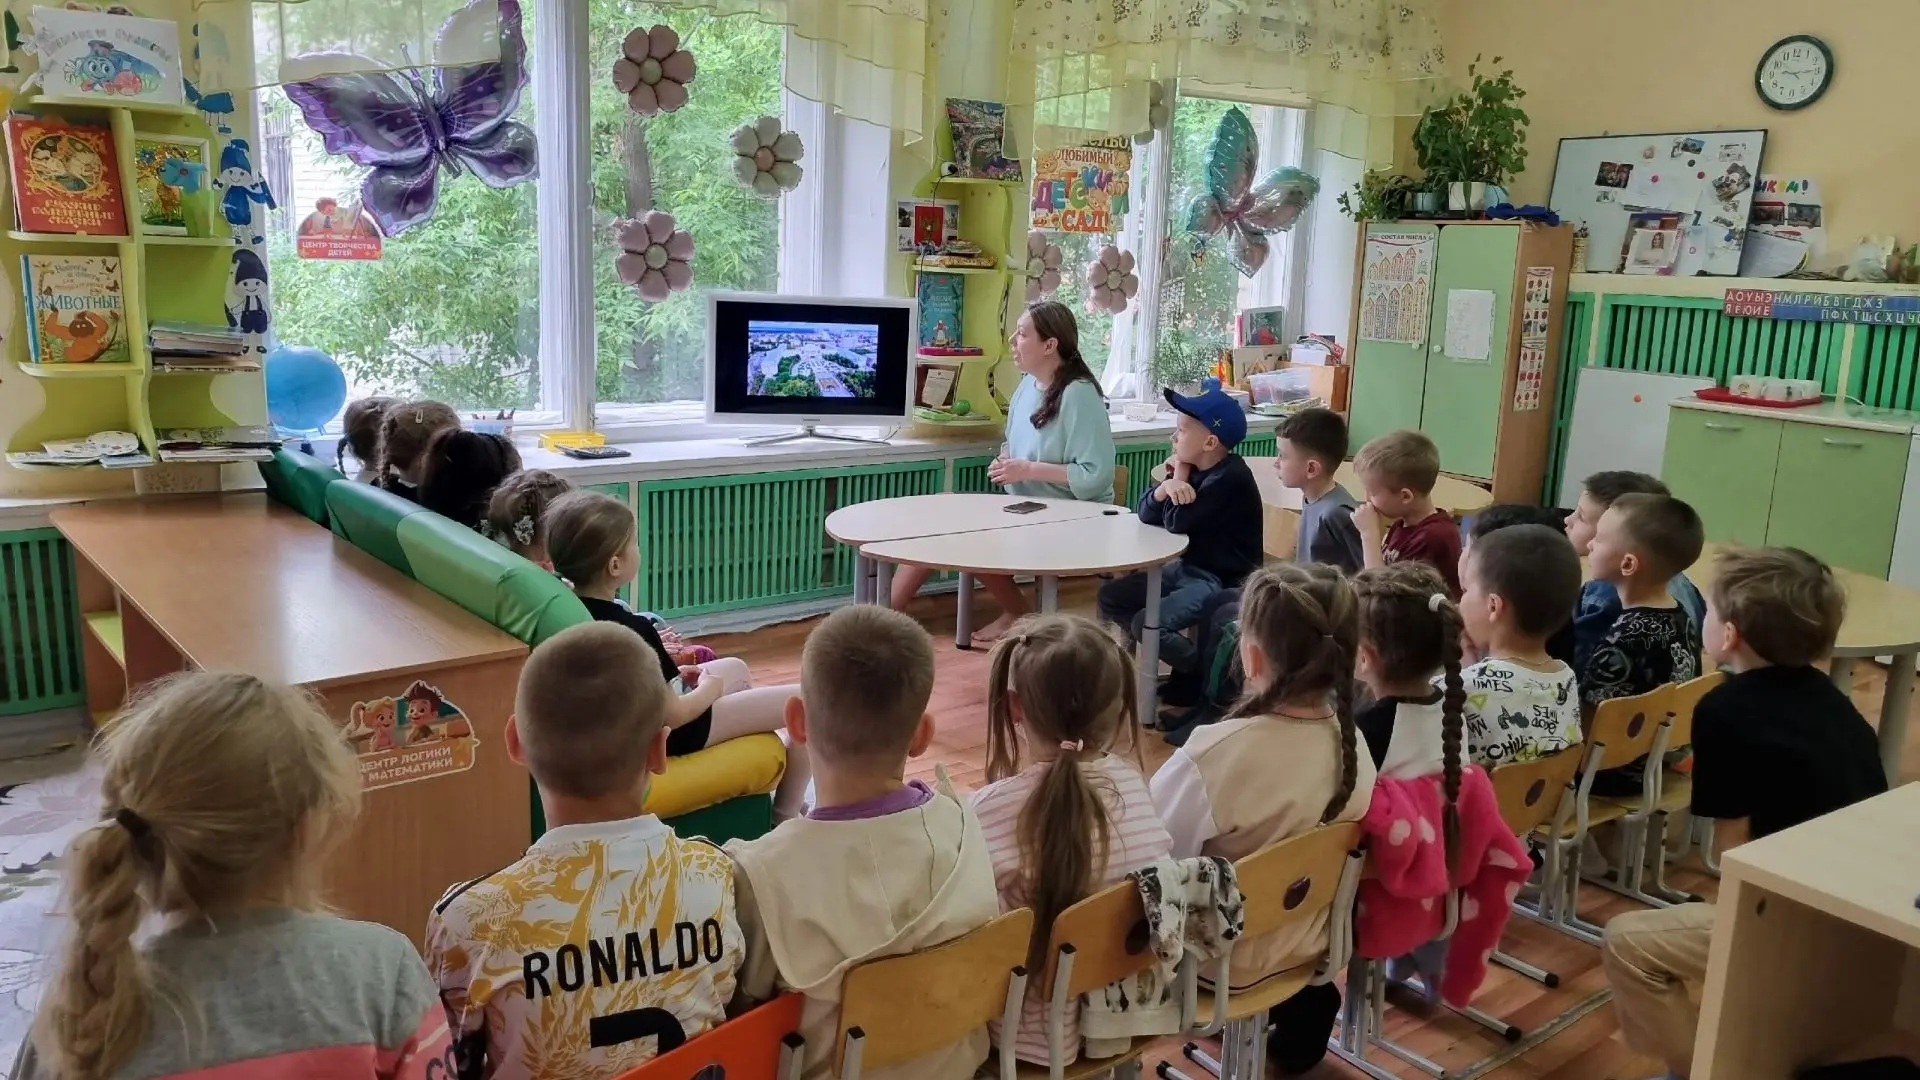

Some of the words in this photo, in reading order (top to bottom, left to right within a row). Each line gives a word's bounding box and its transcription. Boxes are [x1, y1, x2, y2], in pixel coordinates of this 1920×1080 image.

[1062, 209, 1109, 233] САД!
[327, 249, 353, 257] ДЕТЕЙ
[328, 242, 377, 250] ТВОРЧЕСТВА
[36, 294, 121, 311] ЖИВОТНЫЕ
[401, 746, 451, 764] ЛОГИКИ
[369, 757, 453, 781] МАТЕМАТИКИ
[523, 918, 724, 999] RONALDO
